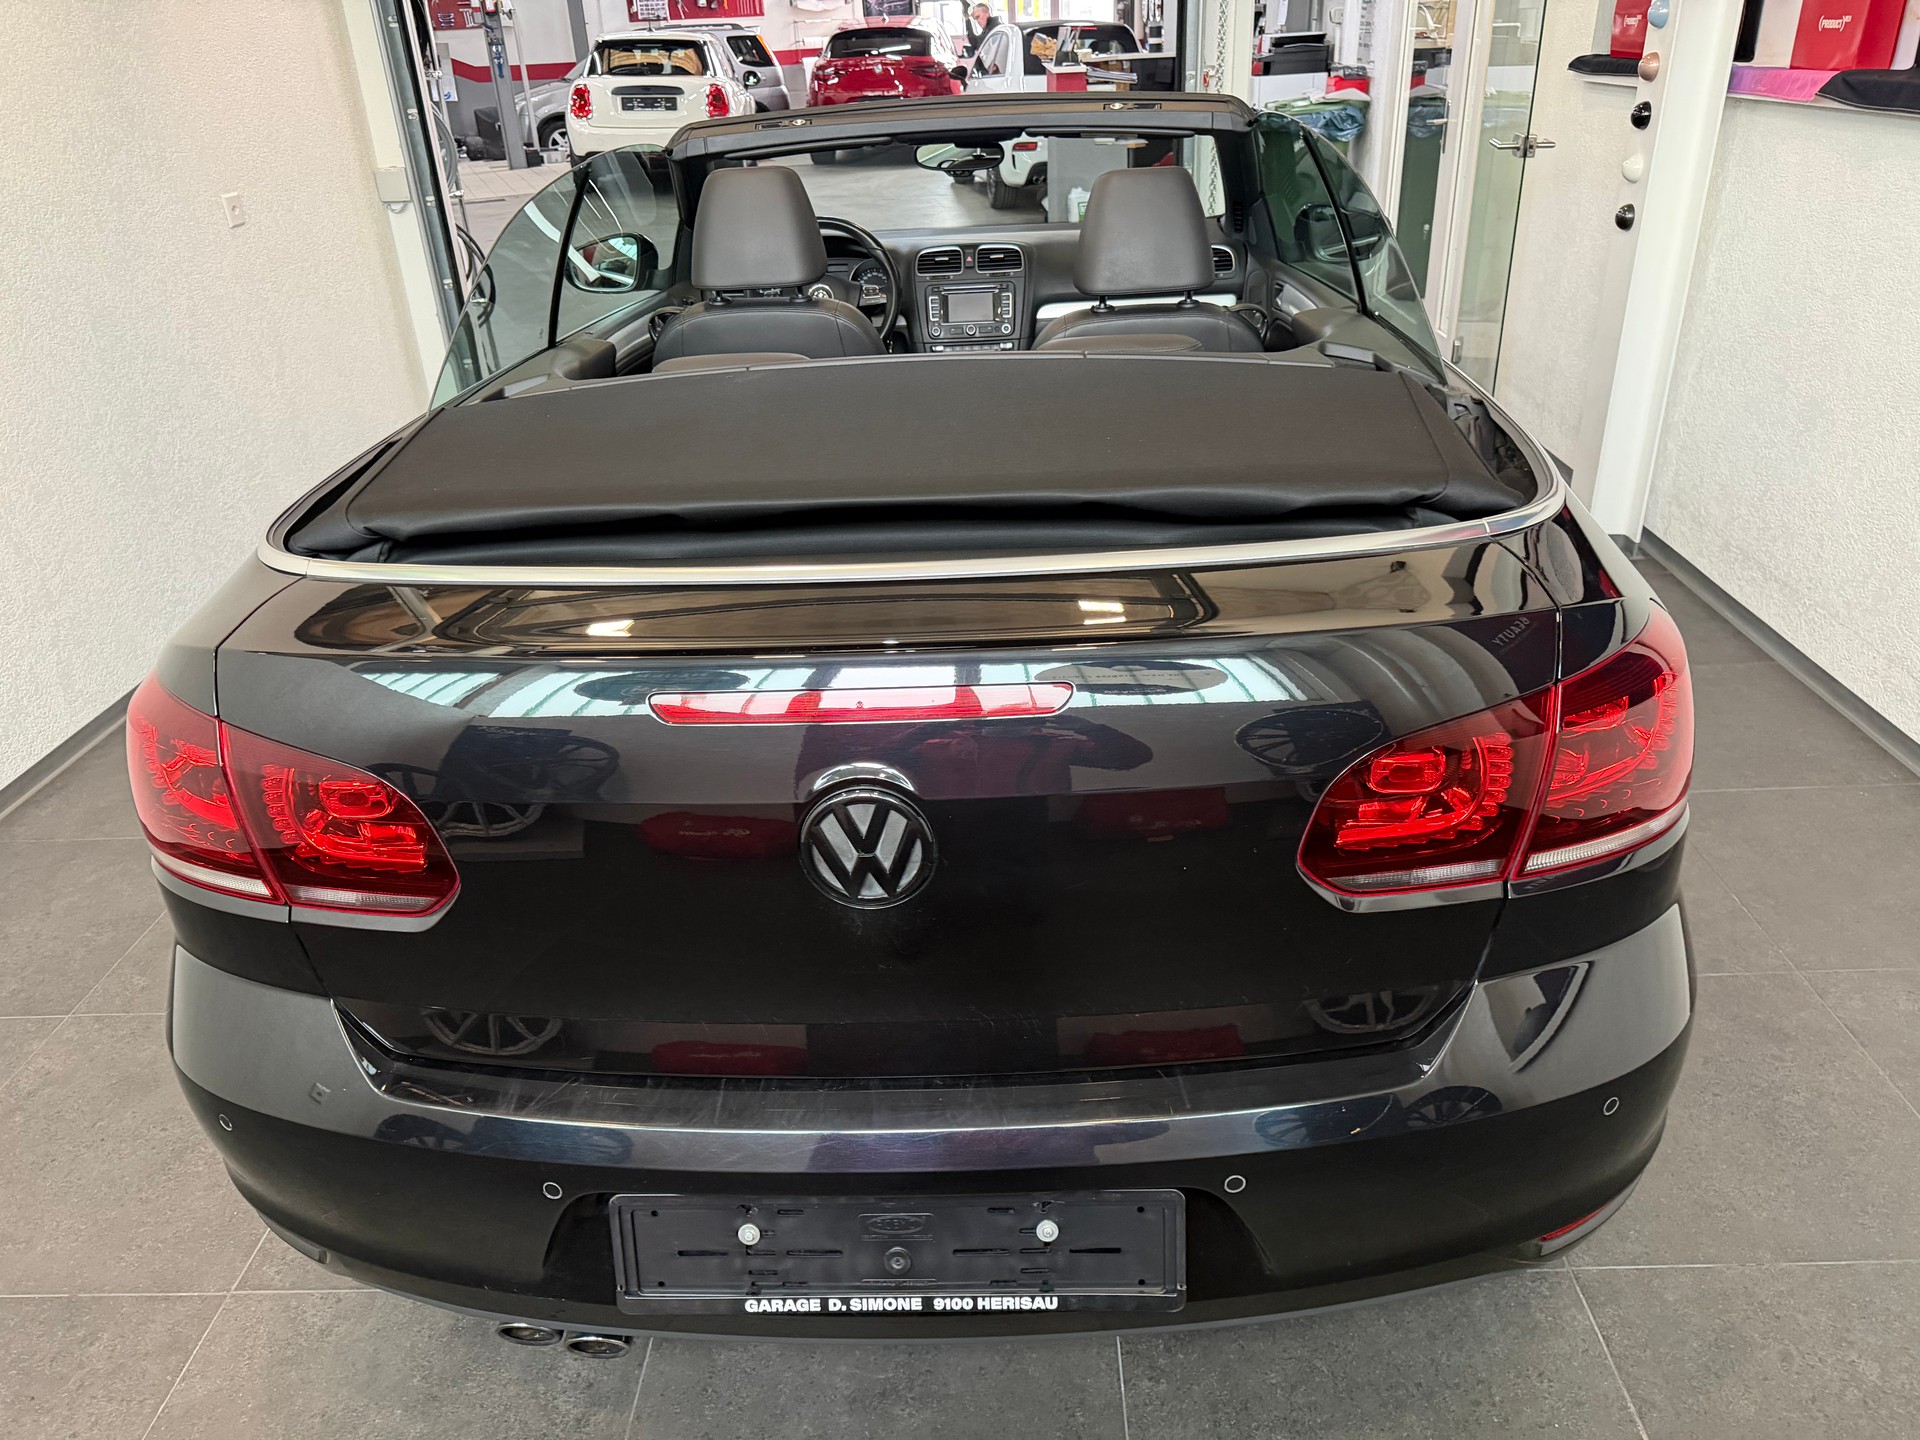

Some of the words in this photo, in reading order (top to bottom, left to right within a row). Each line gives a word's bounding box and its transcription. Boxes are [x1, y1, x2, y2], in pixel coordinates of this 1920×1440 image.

[744, 1299, 821, 1313] GARAGE
[828, 1298, 847, 1312] D.
[849, 1297, 923, 1311] SIMONE
[933, 1297, 974, 1311] 9100
[977, 1296, 1059, 1310] HERISAU
